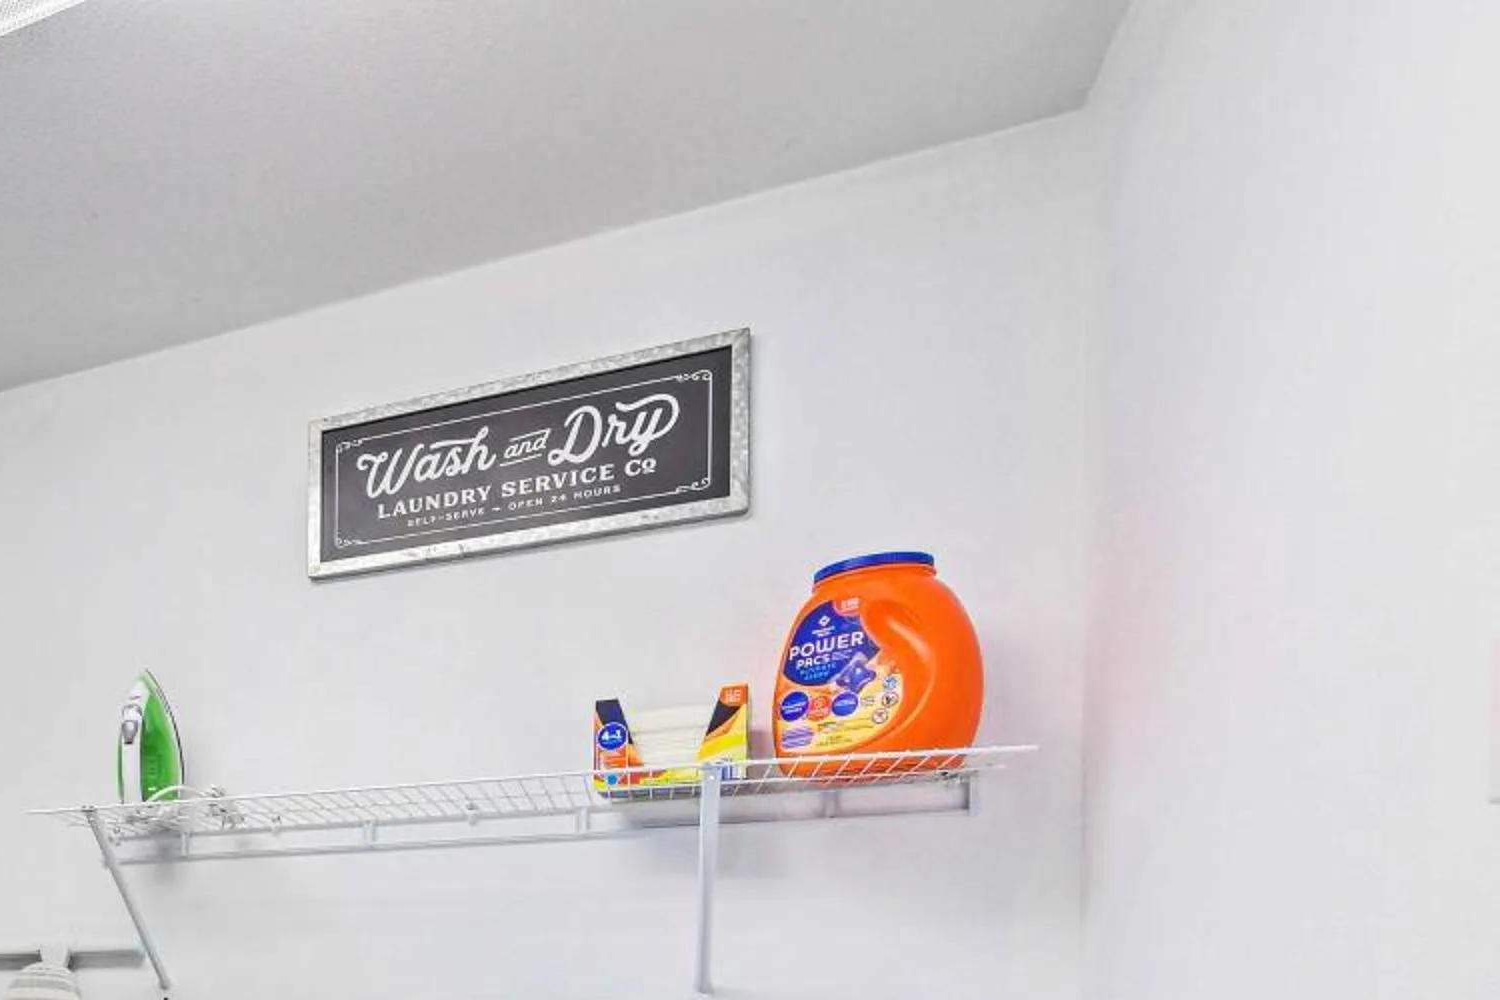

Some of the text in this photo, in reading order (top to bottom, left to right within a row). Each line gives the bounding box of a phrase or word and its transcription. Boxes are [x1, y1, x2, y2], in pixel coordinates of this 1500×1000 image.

[356, 393, 680, 498] Wash and Dry
[377, 485, 492, 519] LAUNDRY
[501, 463, 615, 498] SERVICE
[507, 497, 544, 511] OPEN
[573, 484, 621, 500] HOURS
[789, 631, 864, 661] POWER
